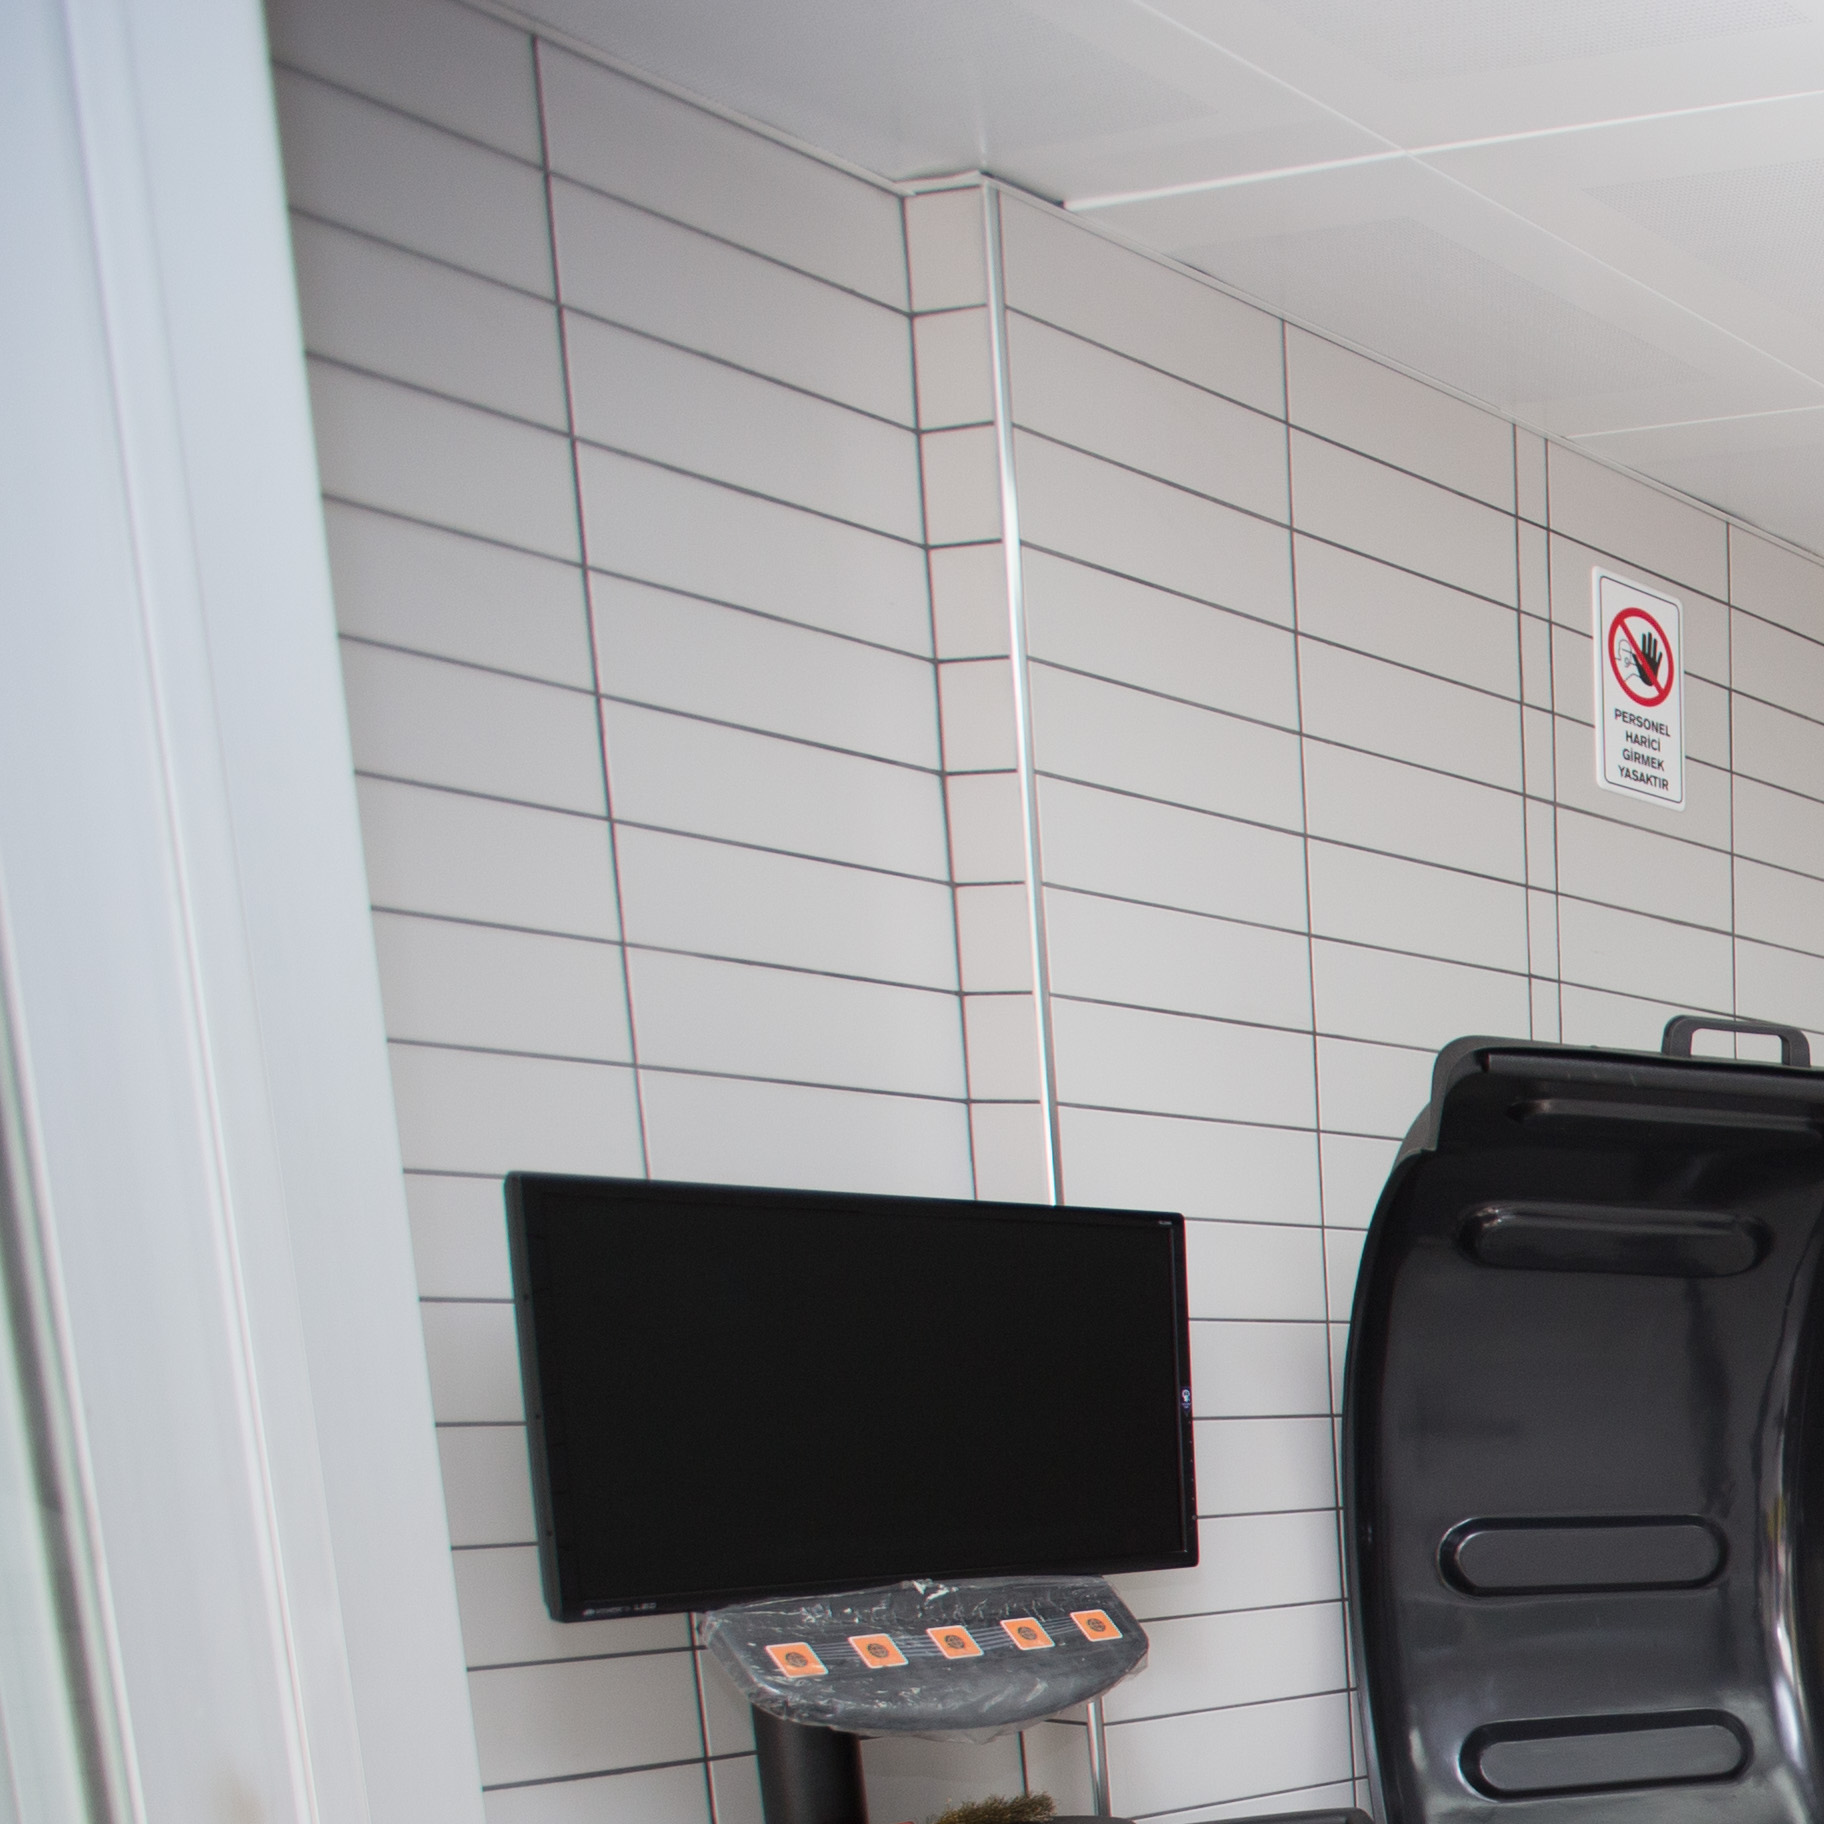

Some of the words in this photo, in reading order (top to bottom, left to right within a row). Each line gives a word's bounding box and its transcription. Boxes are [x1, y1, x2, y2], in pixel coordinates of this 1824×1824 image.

[1614, 708, 1670, 737] PERSONEL
[1622, 747, 1665, 772] GİRMEK
[1618, 764, 1669, 792] YASAKTIR
